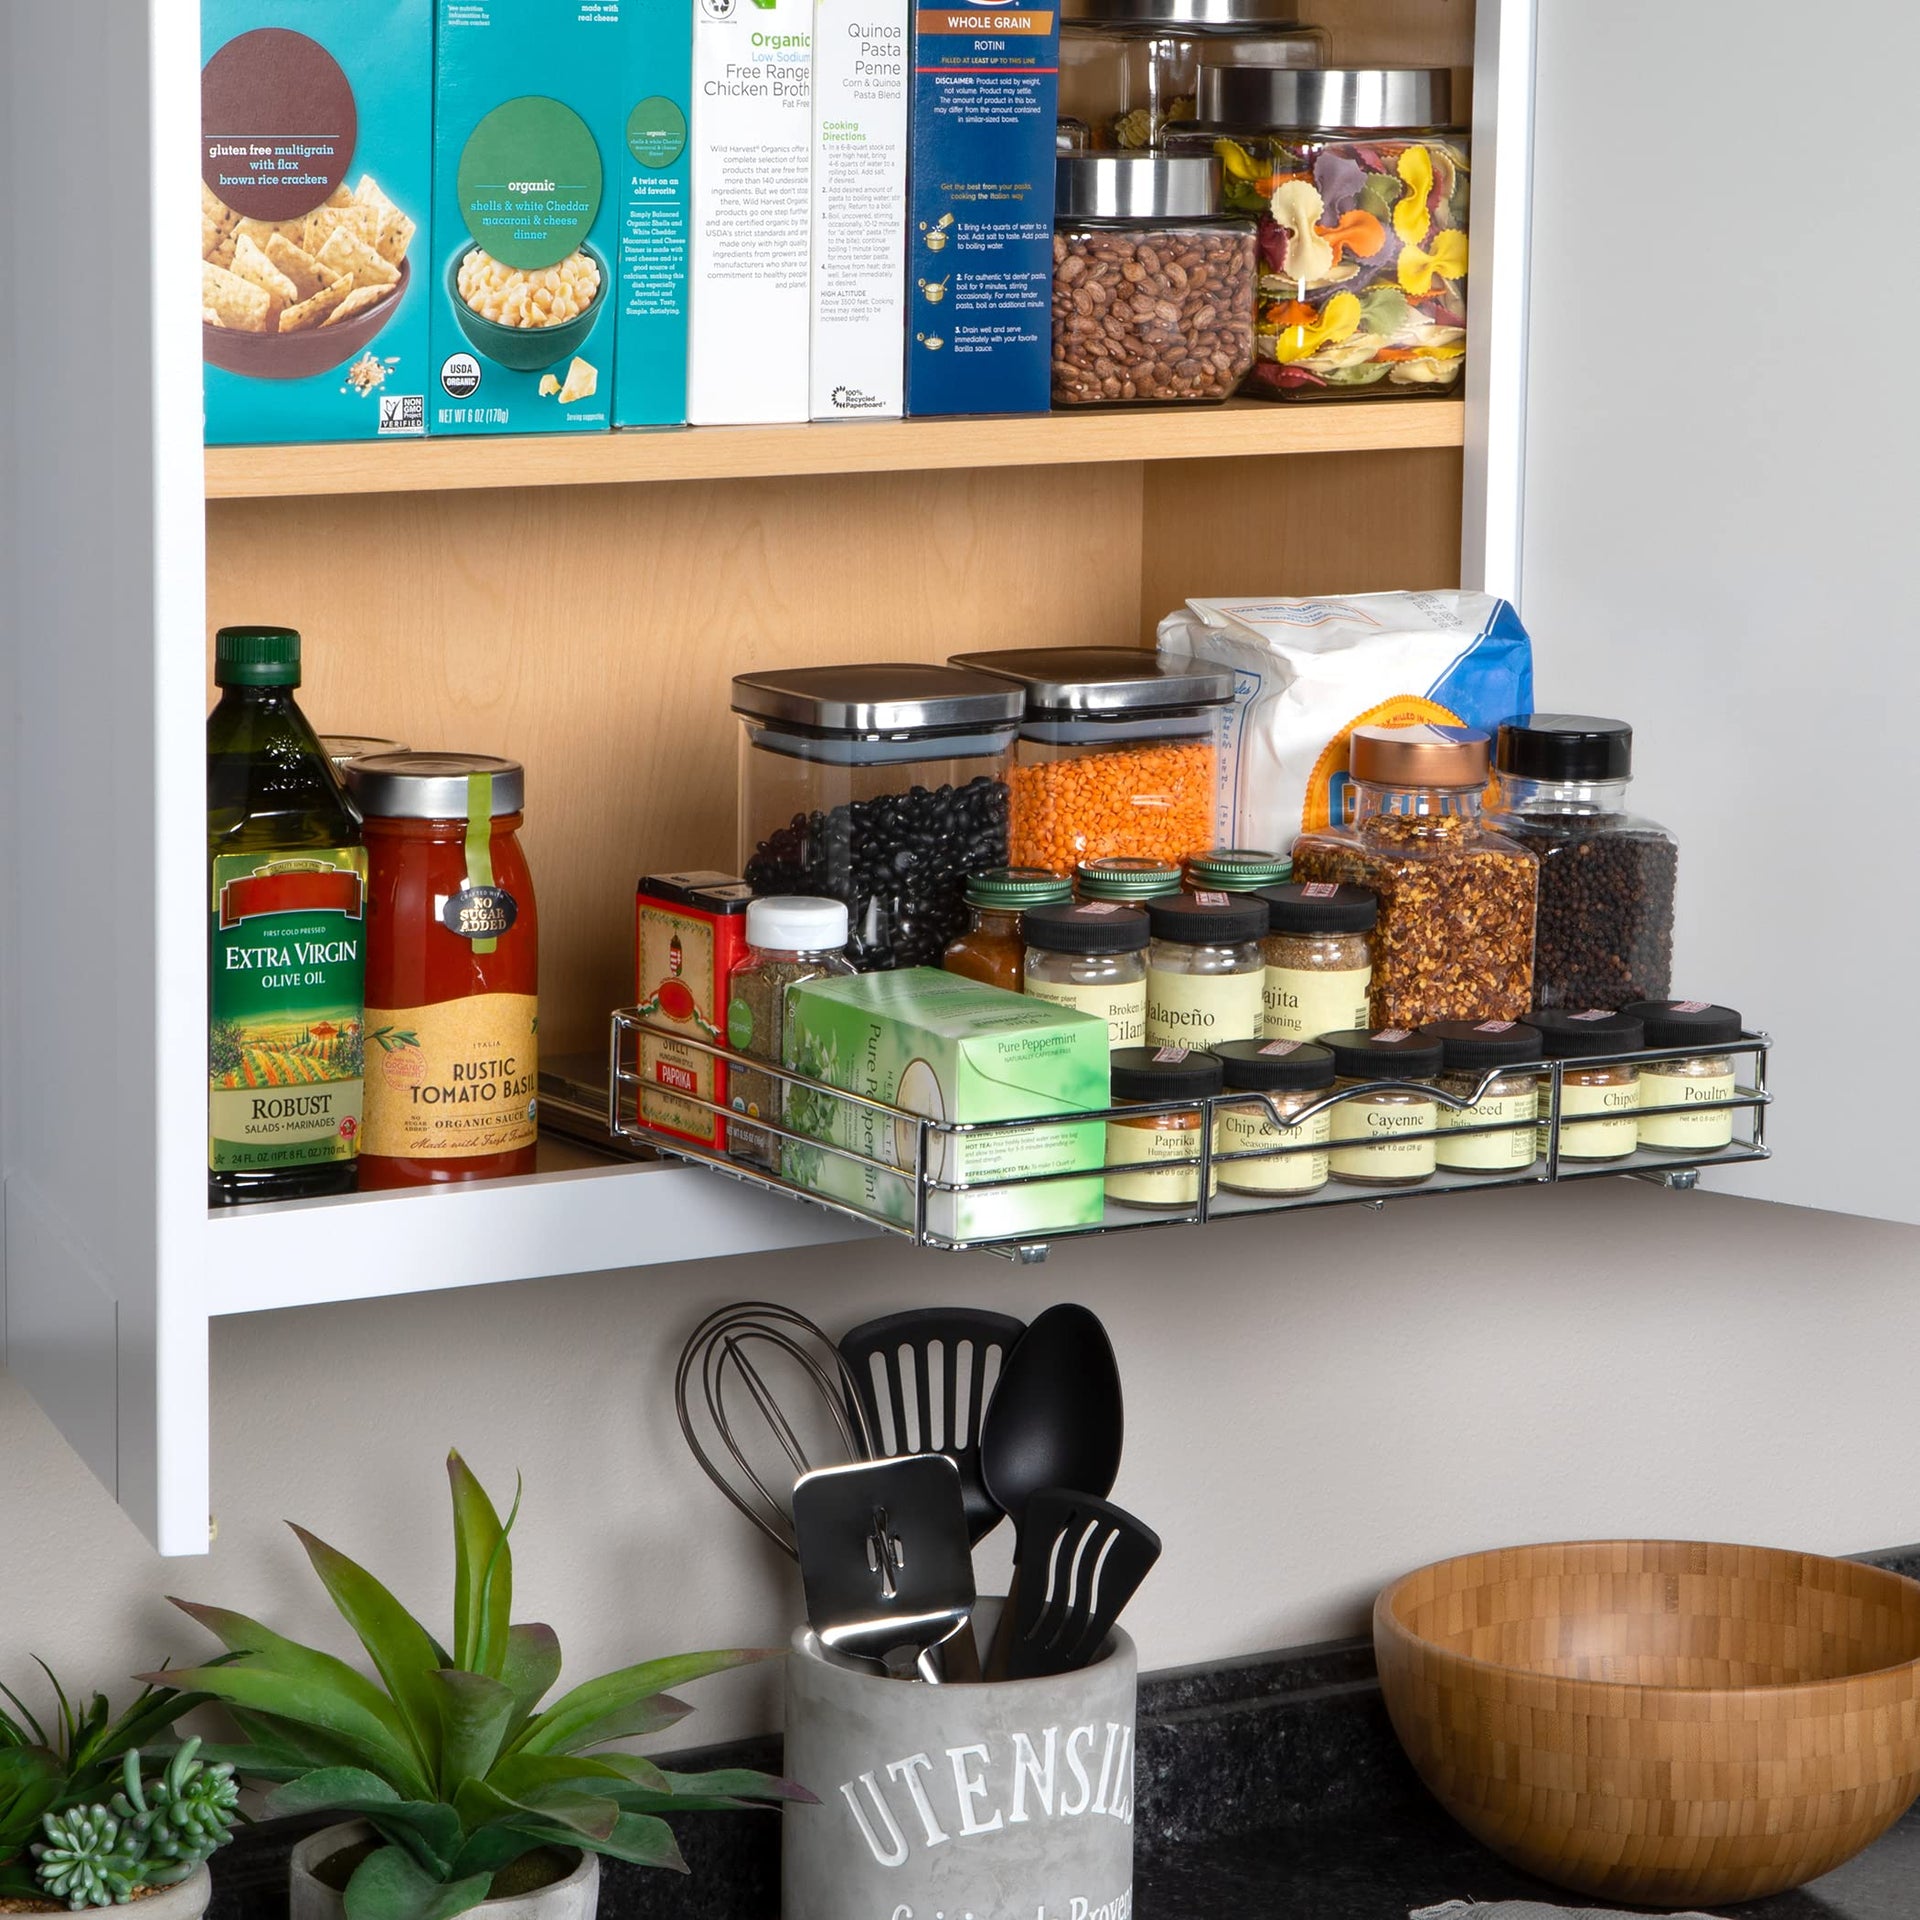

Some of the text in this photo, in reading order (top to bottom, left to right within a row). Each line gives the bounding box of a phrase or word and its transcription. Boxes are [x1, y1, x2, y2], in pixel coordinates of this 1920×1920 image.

[603, 4, 619, 12] with
[578, 13, 618, 22] real cheese
[948, 17, 1031, 29] WHOLE GRAIN
[848, 23, 900, 39] Quinoa
[751, 32, 810, 50] Organic
[975, 41, 1005, 50] ROTINI
[861, 42, 900, 56] Pasta
[752, 52, 810, 62] Low Sodium
[726, 64, 810, 81] Free Range
[855, 60, 900, 75] Penne
[704, 81, 810, 96] Chicken Broth
[843, 79, 900, 88] Corn & Quinoa
[854, 91, 900, 99] Pasta Blend
[782, 100, 794, 108] Fat
[823, 121, 859, 131] Cooking
[209, 144, 334, 158] gluten free multigrain
[250, 159, 298, 170] with flax
[220, 174, 328, 185] brown rice crackers
[631, 177, 638, 185] A
[639, 177, 657, 185] twist
[508, 180, 555, 194] organic
[634, 187, 676, 195] old favorite
[471, 200, 589, 211] shells & white Cheddar
[482, 216, 577, 225] macaroni & cheese
[514, 229, 547, 239] dinner
[450, 364, 472, 374] USDA
[446, 377, 476, 386] ORGANIC
[439, 409, 453, 423] NET
[455, 409, 466, 422] WT
[468, 409, 472, 422] 6
[475, 409, 484, 422] OZ
[382, 420, 422, 428] VERIFIED
[473, 897, 492, 908] NO
[460, 908, 504, 921] SUGAR
[460, 919, 506, 932] ADDED
[226, 940, 357, 969] EXTRA VIRGIN
[262, 971, 326, 988] OLIVE OIL
[1263, 986, 1298, 1010] ajita
[1109, 1003, 1139, 1016] Broken
[1108, 1021, 1145, 1041] Cilan
[473, 1041, 500, 1049] ITALIA
[866, 1024, 881, 1073] Pure
[998, 1033, 1076, 1053] Pure Peppermint
[453, 1057, 516, 1081] RUSTIC
[662, 1066, 691, 1089] PAPRIKA
[411, 1073, 534, 1104] TOMATO BASIL
[1684, 1087, 1728, 1101] Poultry
[252, 1095, 332, 1120] ROBUST
[1470, 1102, 1502, 1115] Seed
[245, 1118, 335, 1134] SALADS MARINADES
[435, 1111, 524, 1129] ORGANIC SAUCE
[1226, 1117, 1255, 1136] Chip
[1259, 1122, 1273, 1136] &
[1367, 1112, 1424, 1129] Cayenne
[1155, 1135, 1194, 1149] Paprika
[840, 1722, 1134, 1867] UTENSIL
